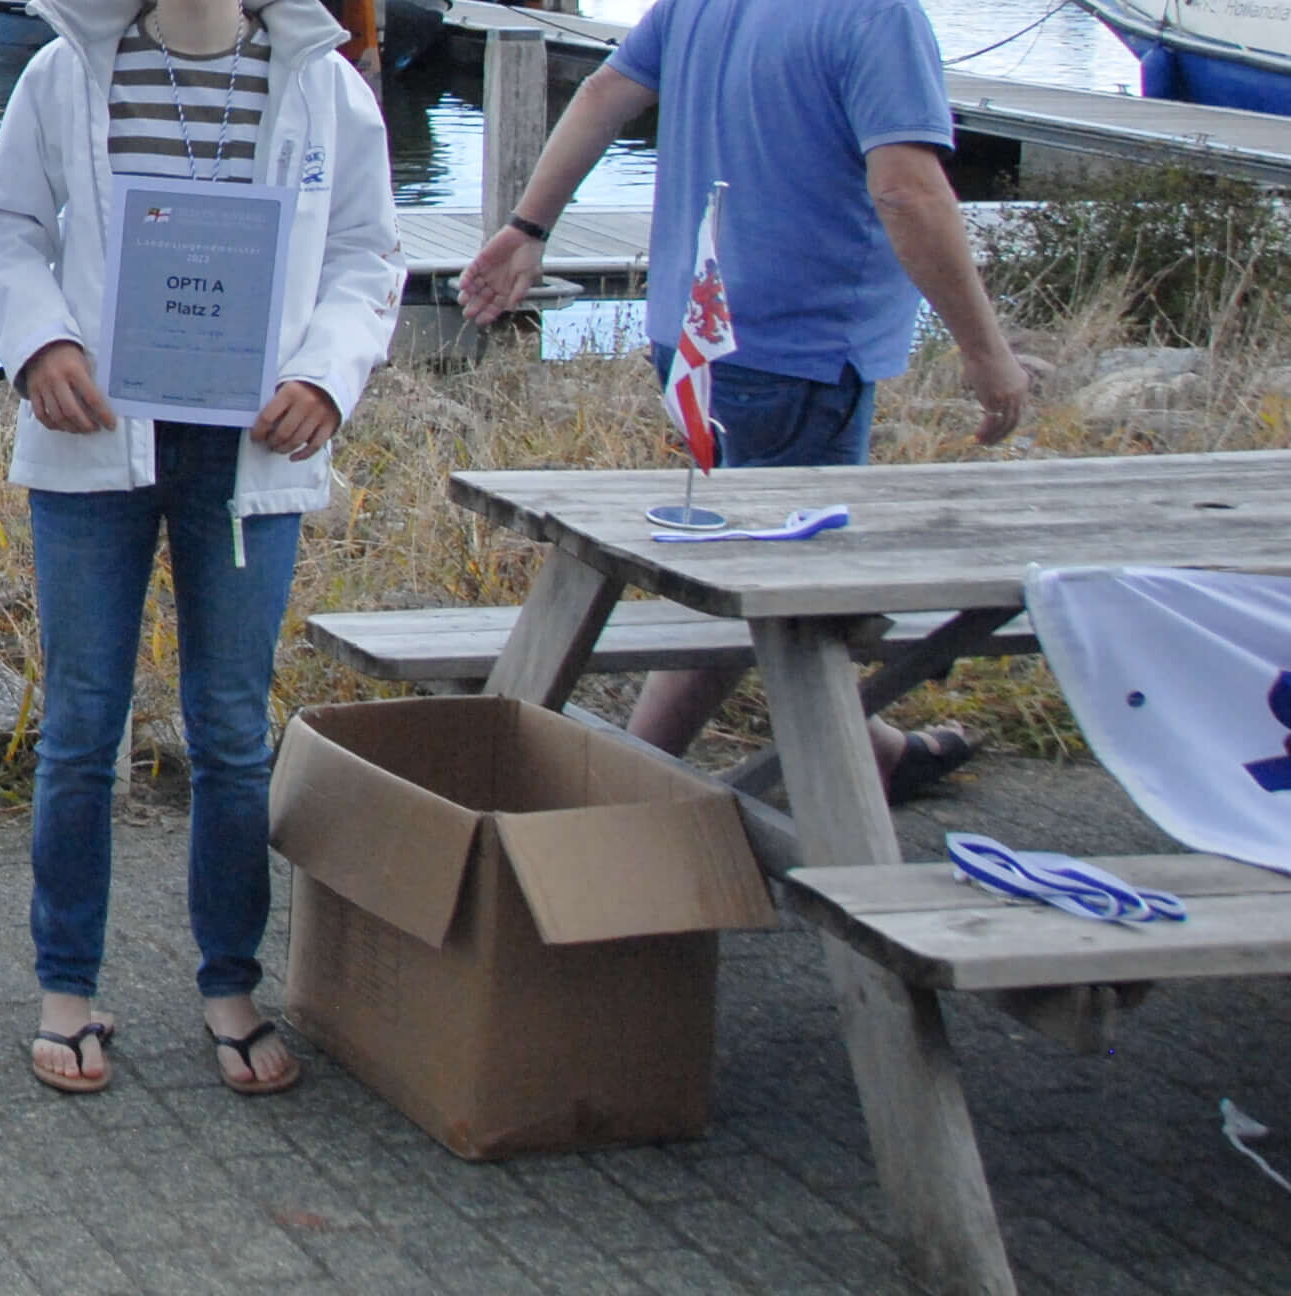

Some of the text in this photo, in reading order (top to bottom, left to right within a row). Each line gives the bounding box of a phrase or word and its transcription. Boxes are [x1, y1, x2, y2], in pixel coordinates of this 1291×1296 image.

[166, 275, 225, 293] OPTI A
[165, 300, 221, 317] Platz 2
